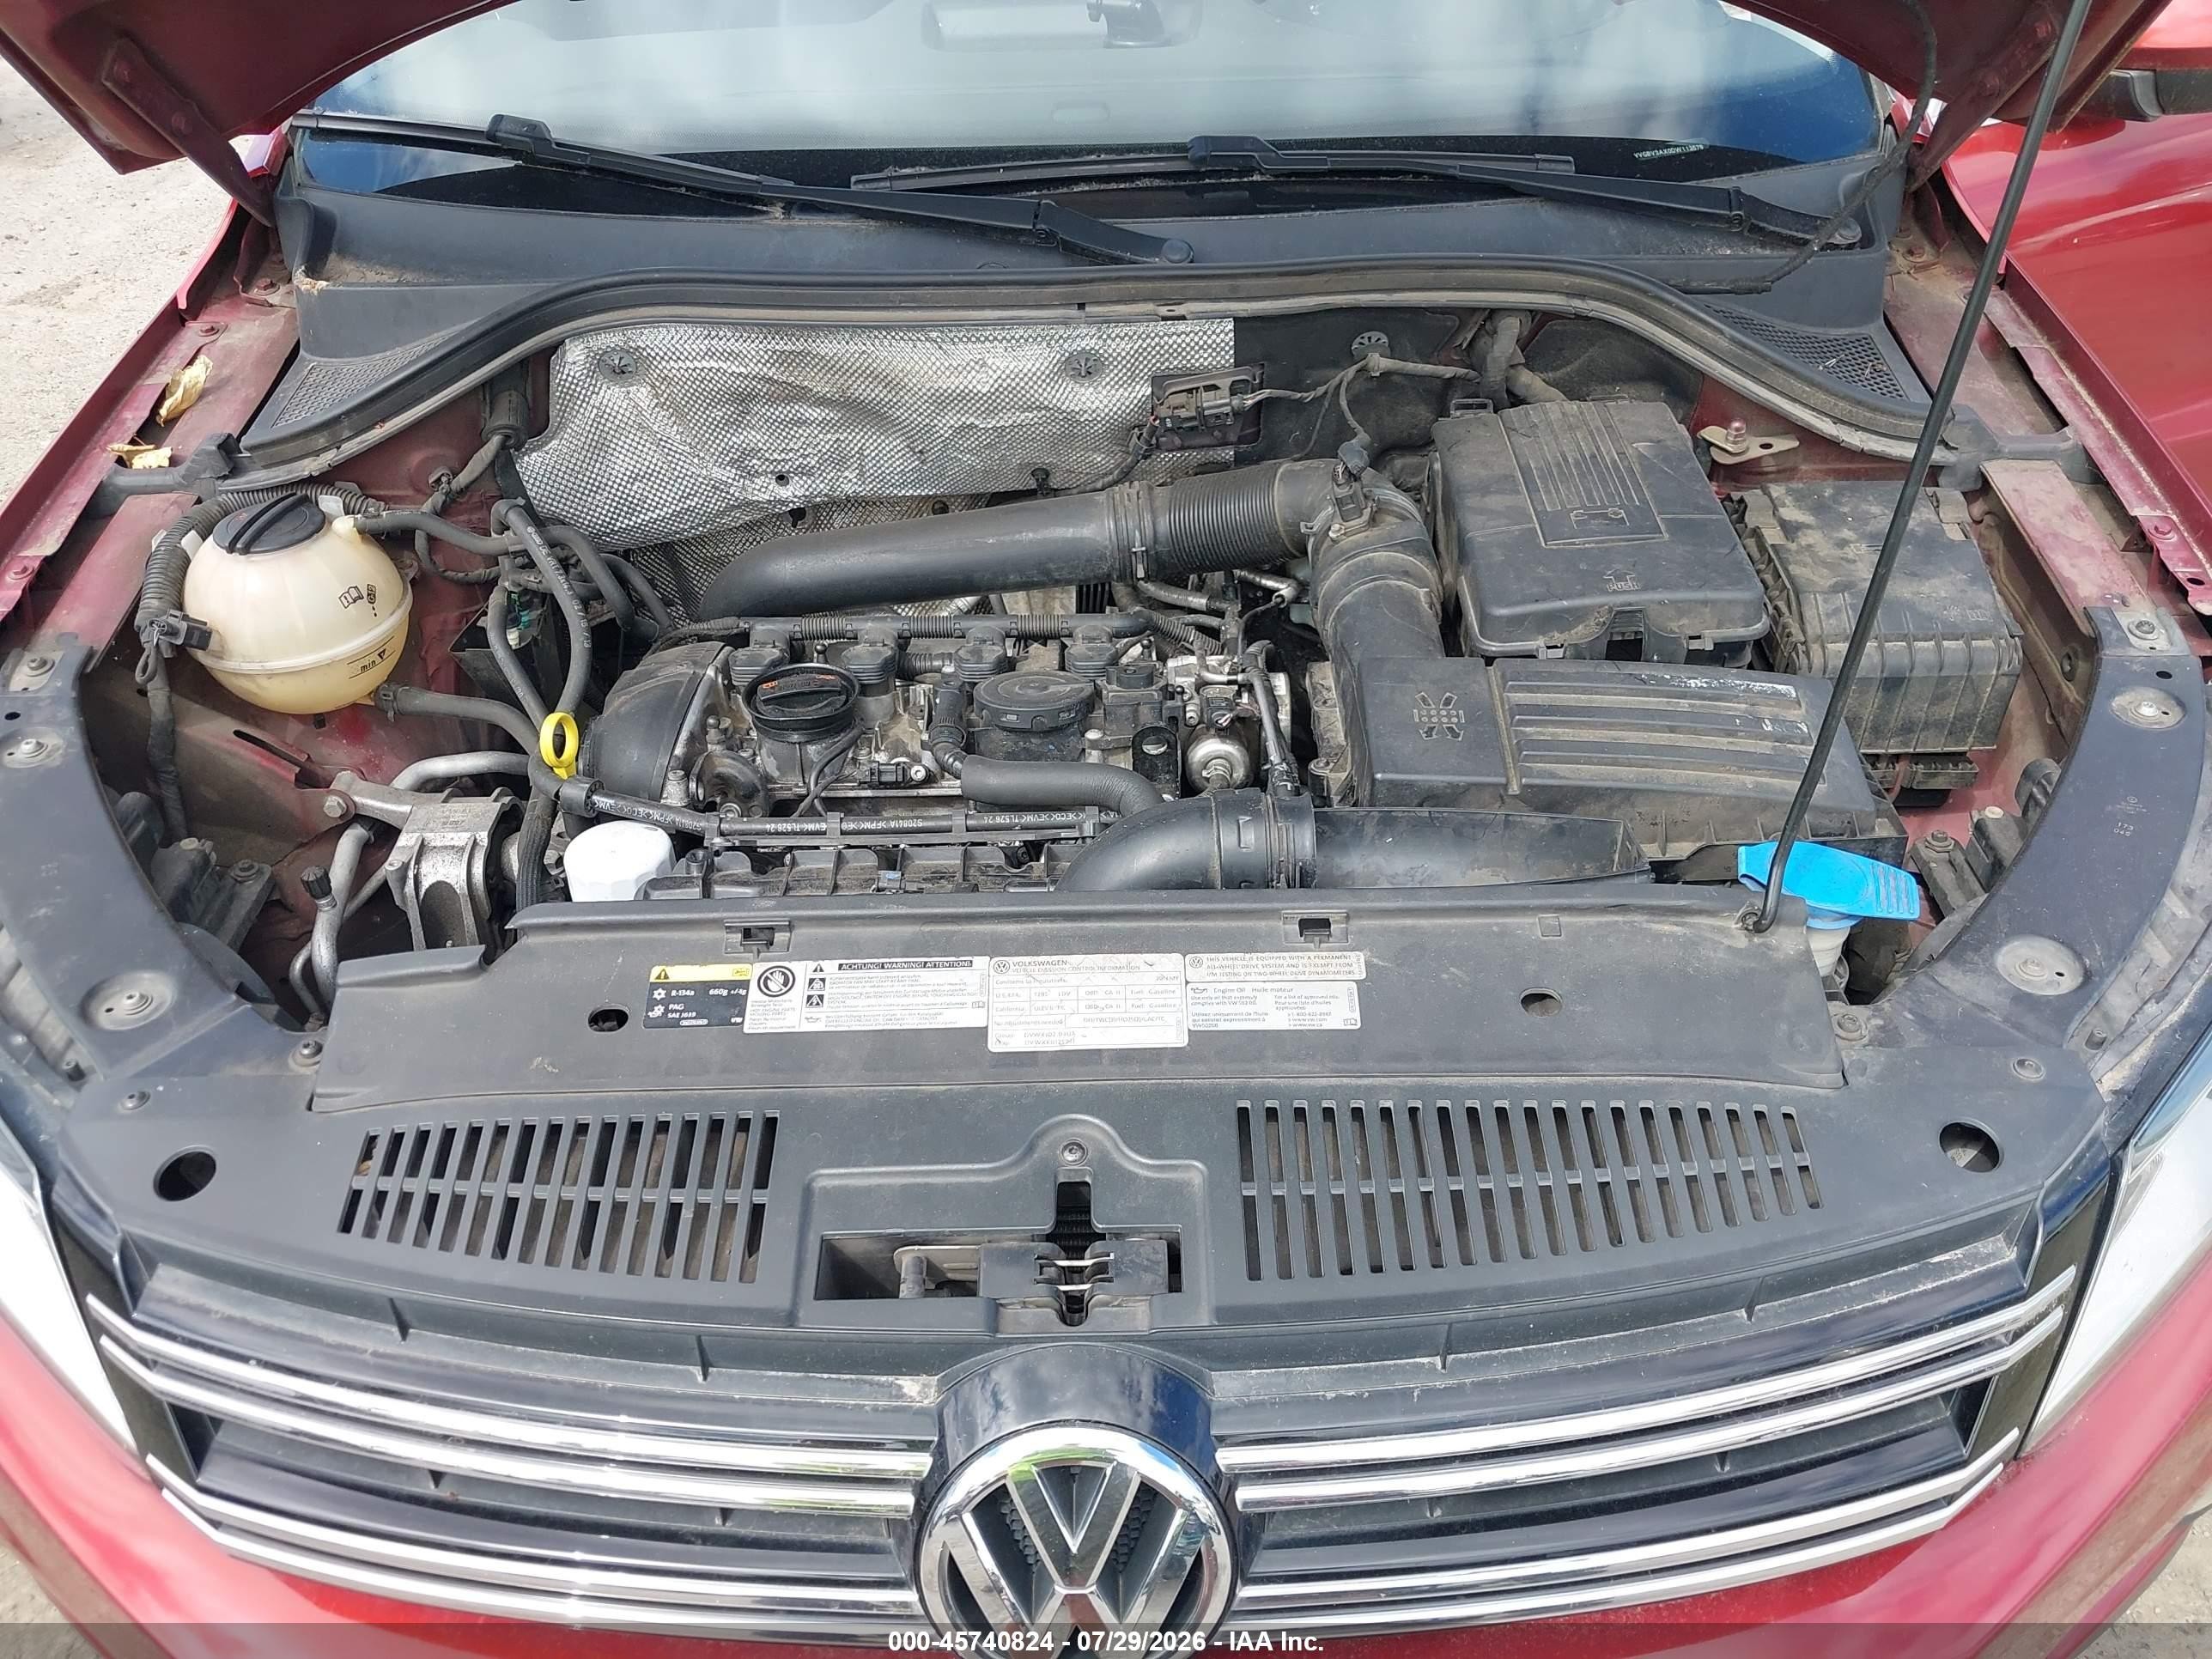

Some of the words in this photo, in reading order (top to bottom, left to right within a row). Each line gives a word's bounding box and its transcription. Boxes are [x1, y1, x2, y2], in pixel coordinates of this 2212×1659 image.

[1607, 581, 1642, 592] PUSH
[360, 660, 376, 672] min
[884, 961, 925, 969] WARNING!
[671, 988, 695, 997] R-134a
